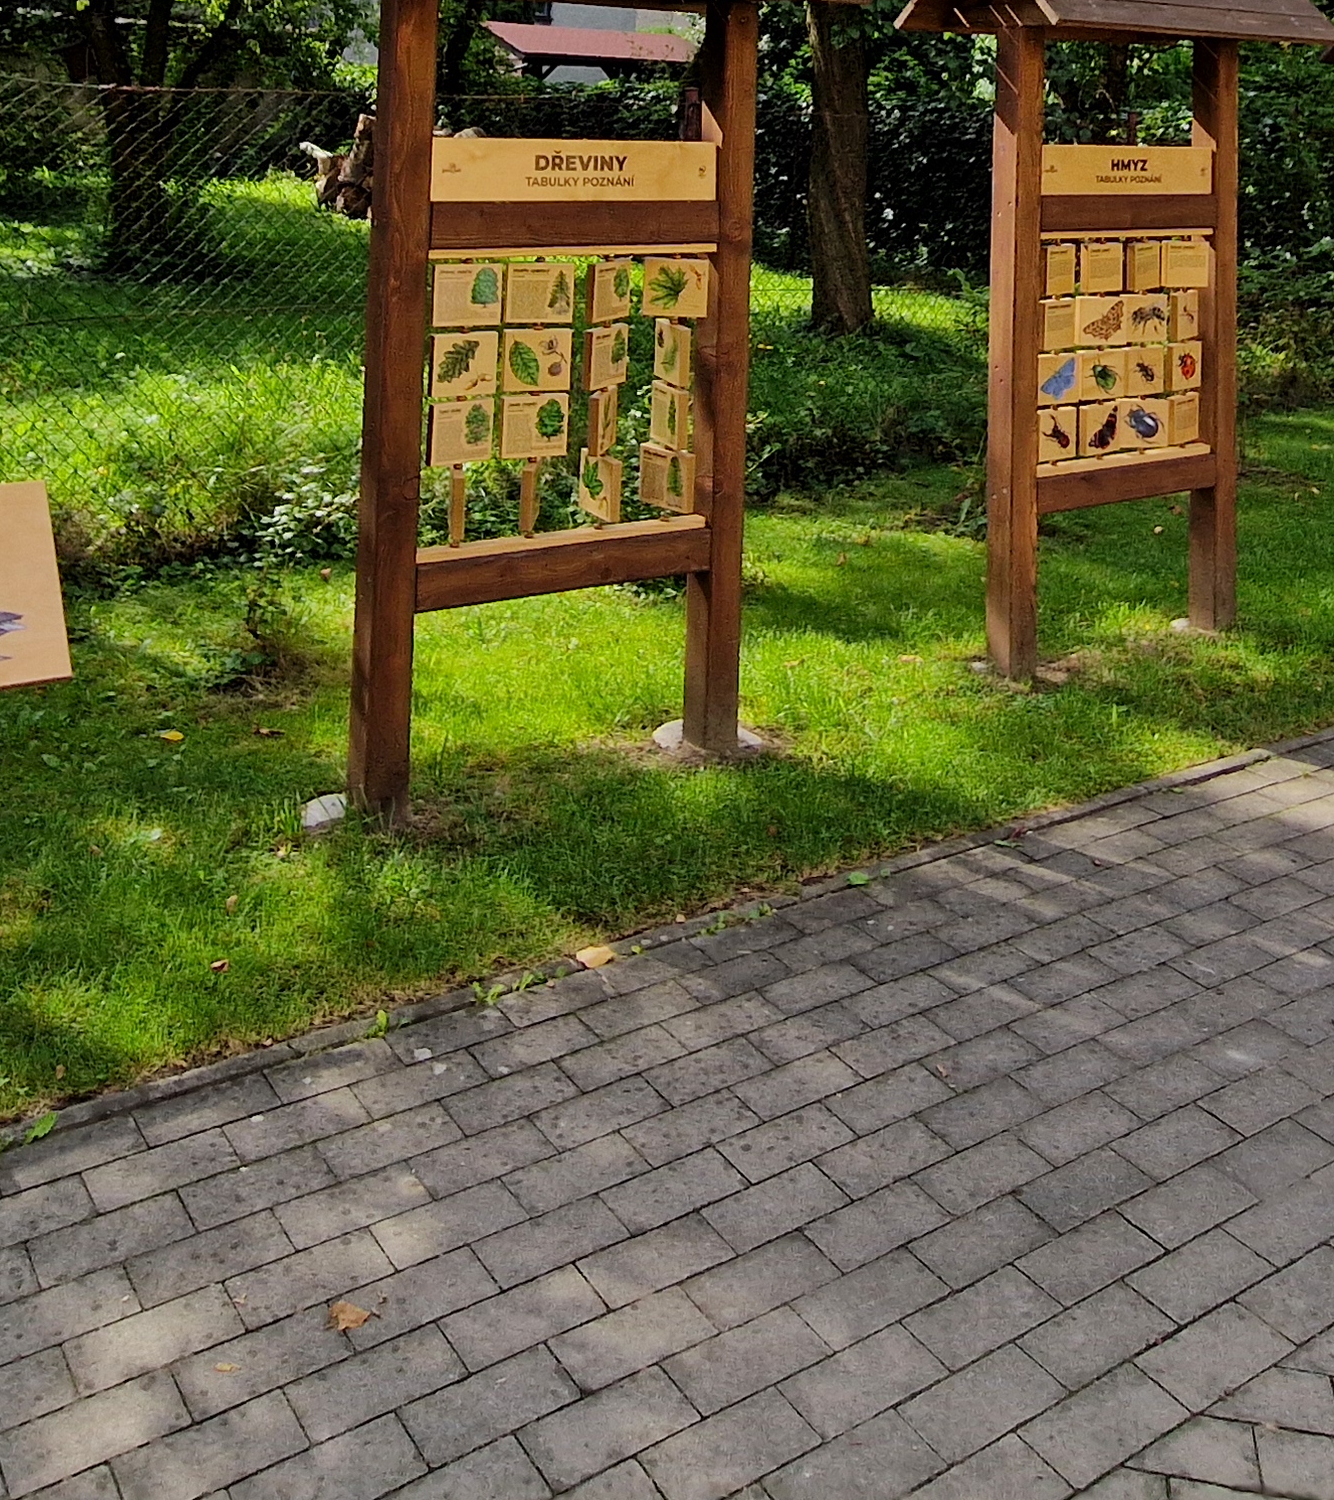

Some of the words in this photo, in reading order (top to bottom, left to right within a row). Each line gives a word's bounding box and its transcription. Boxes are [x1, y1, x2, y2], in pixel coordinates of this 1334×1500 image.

[534, 150, 628, 172] DŘEVINY
[1111, 159, 1148, 172] HMYZ
[525, 176, 579, 187] TABULKY
[582, 174, 635, 187] POZNÁNÍ
[1096, 175, 1128, 183] TABULKY
[1130, 173, 1162, 183] POZNÁNÍ
